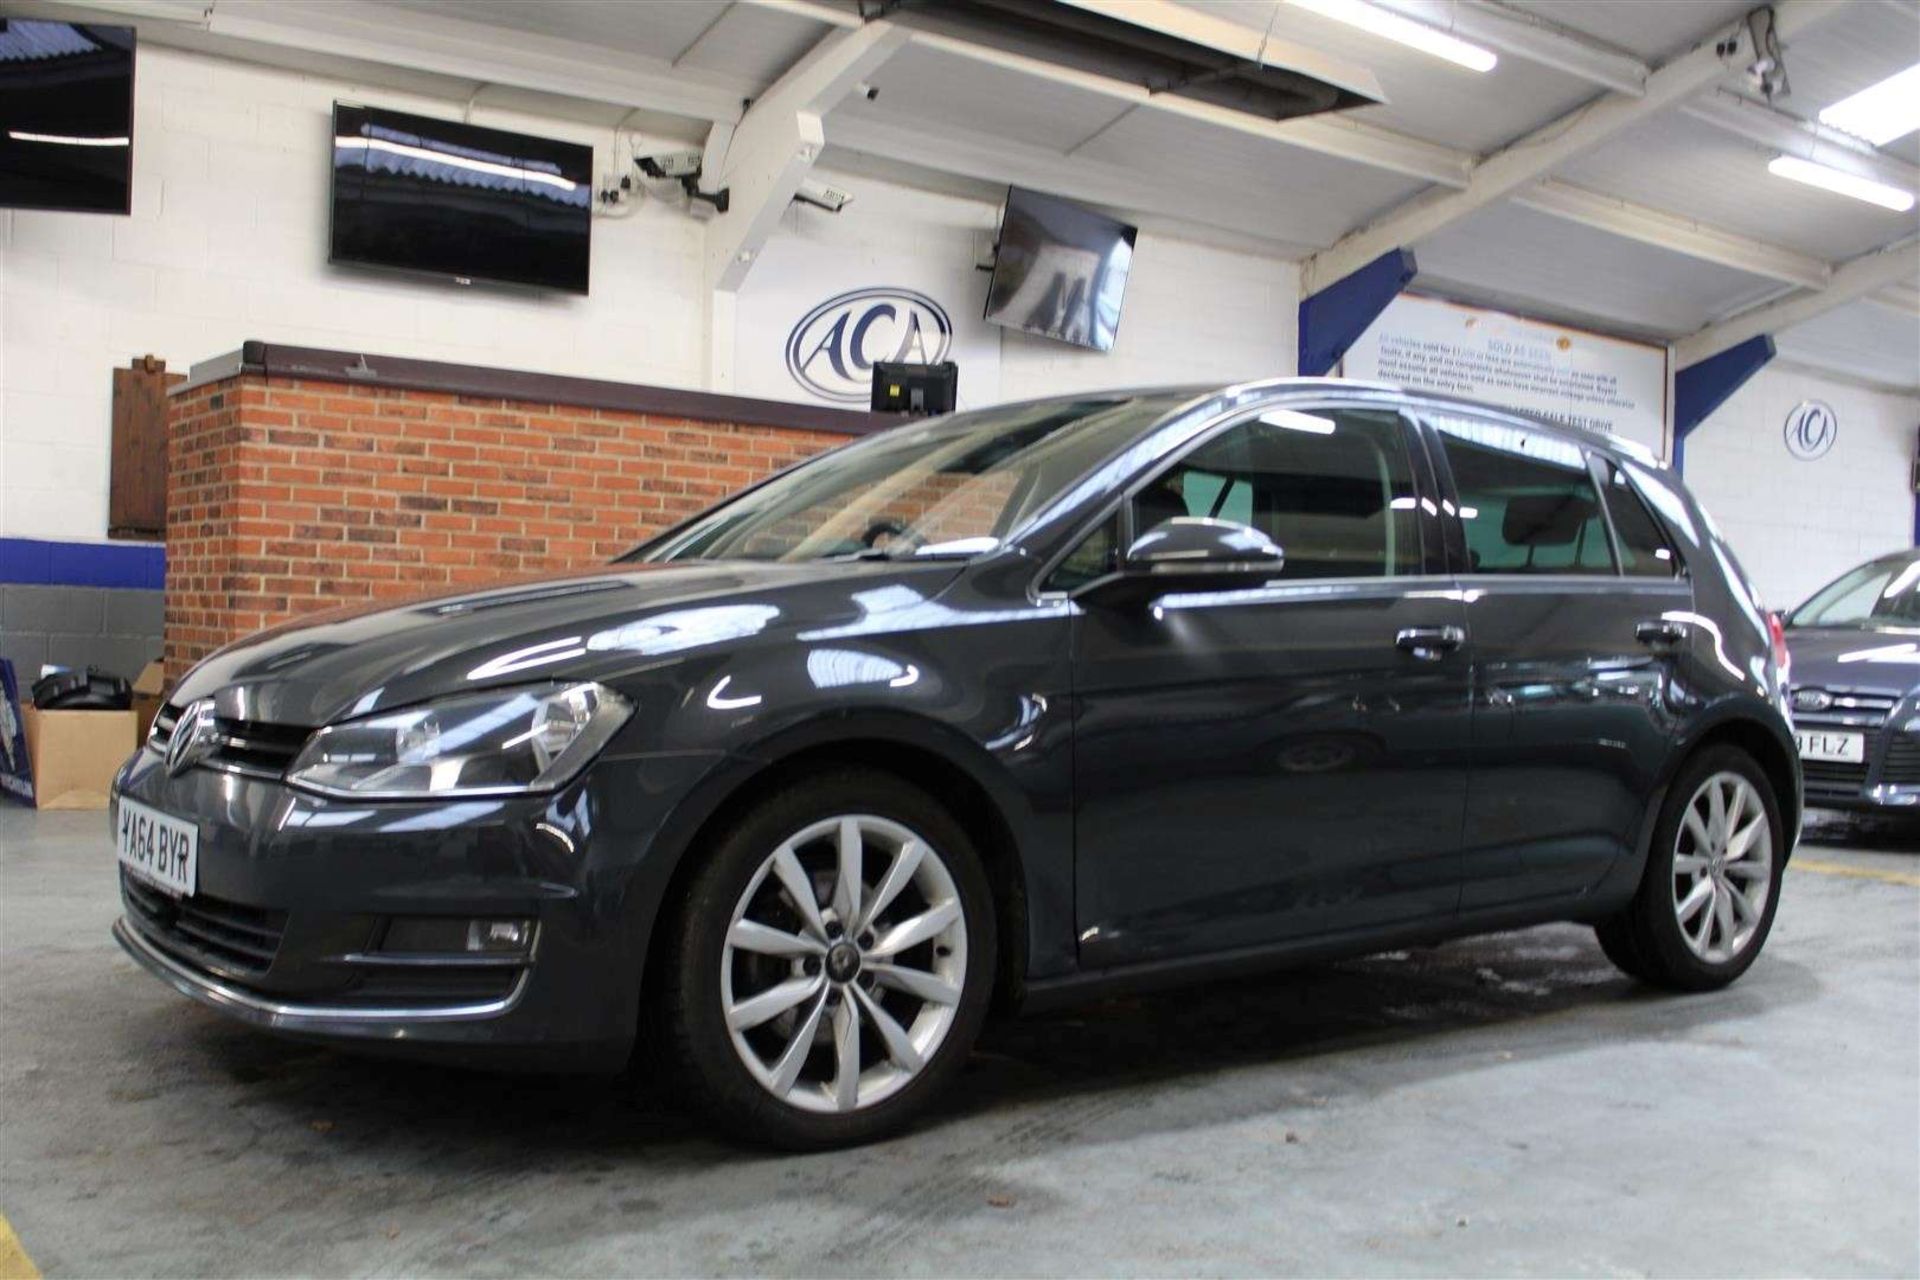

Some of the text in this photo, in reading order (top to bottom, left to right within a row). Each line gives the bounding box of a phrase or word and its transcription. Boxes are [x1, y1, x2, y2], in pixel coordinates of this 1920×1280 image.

[800, 303, 928, 383] ACA
[1809, 735, 1849, 756] FLZ
[122, 806, 154, 869] YA64
[158, 825, 190, 884] BYR
